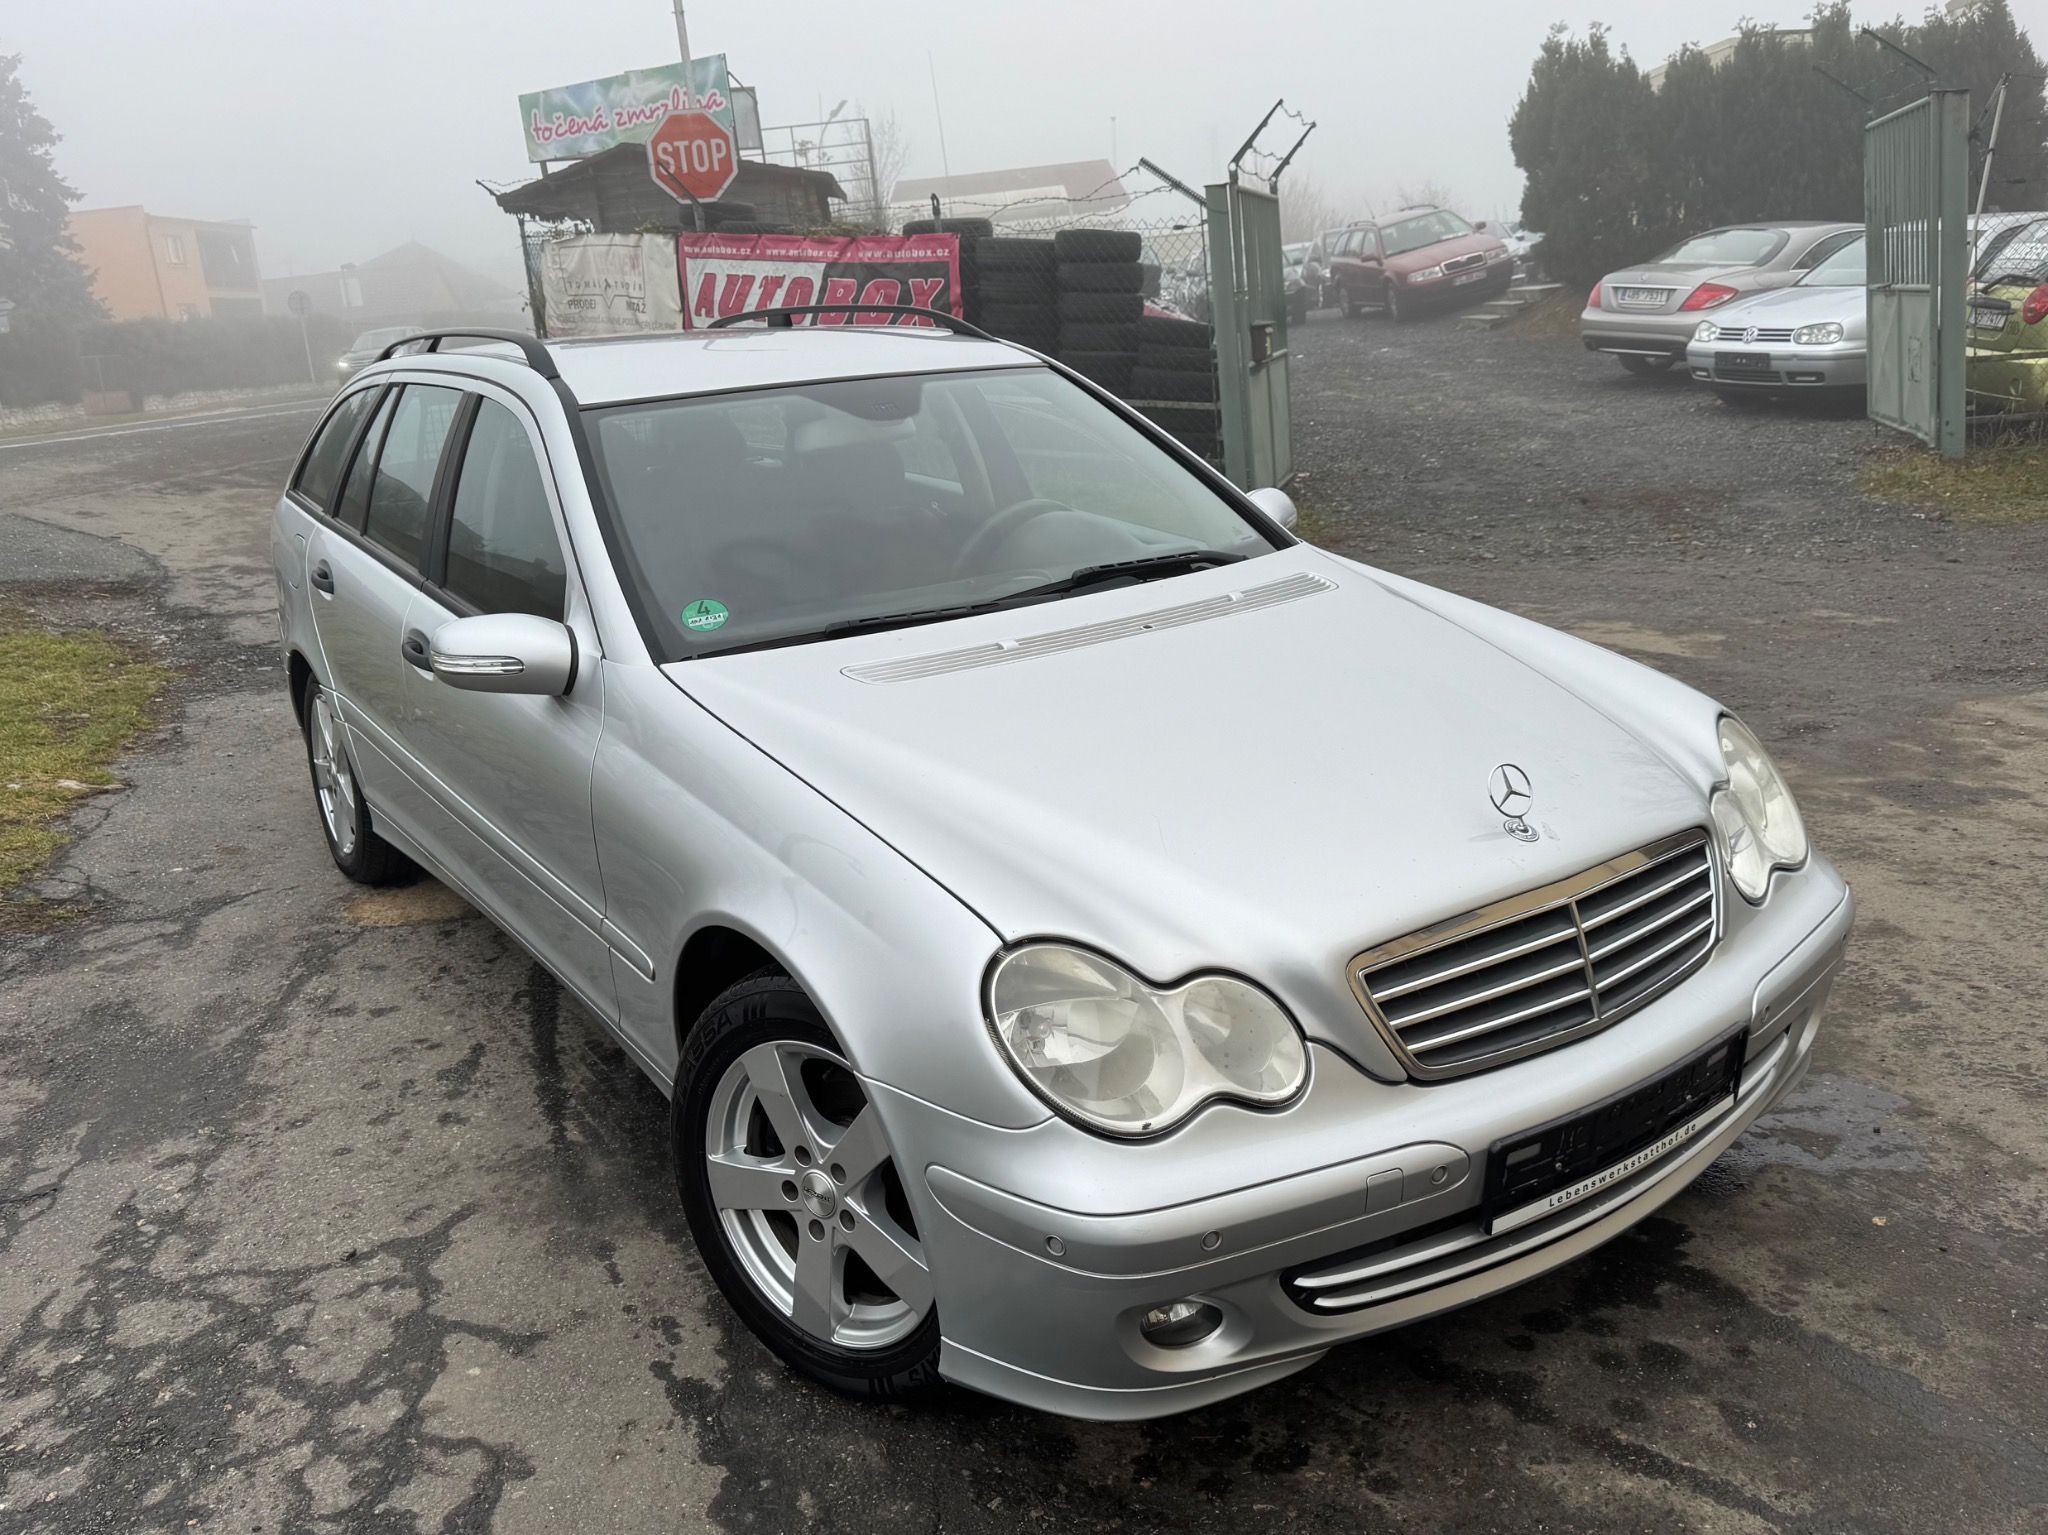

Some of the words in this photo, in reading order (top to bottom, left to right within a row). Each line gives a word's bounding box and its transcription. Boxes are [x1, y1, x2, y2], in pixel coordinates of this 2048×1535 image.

[532, 107, 609, 142] točená
[656, 138, 727, 176] STOP
[683, 246, 752, 256] www.autobox.cz
[858, 248, 950, 258] www.autobox.cz
[697, 600, 711, 615] 4
[1549, 1122, 1697, 1208] Lebenswerkstatthof.de
